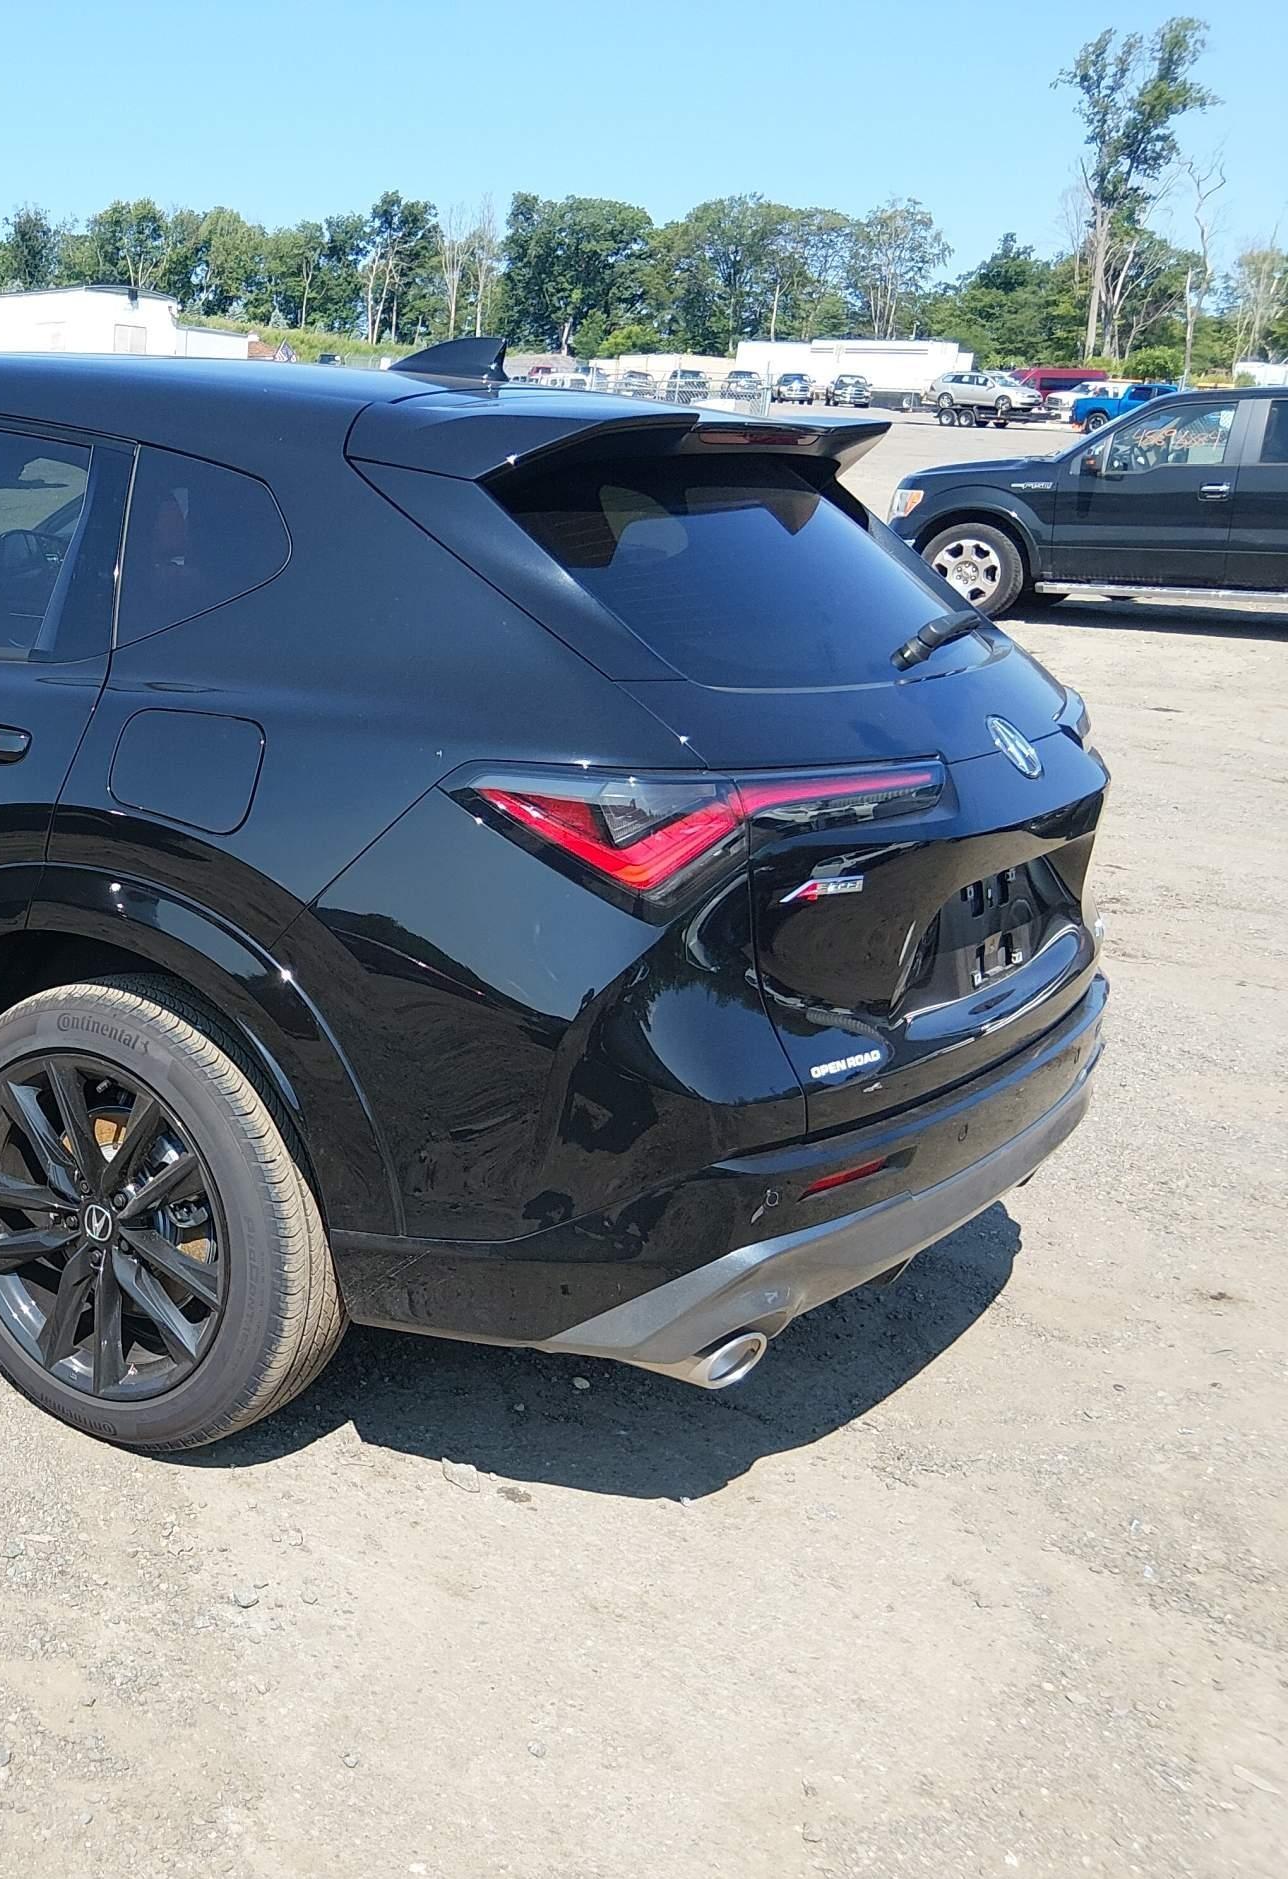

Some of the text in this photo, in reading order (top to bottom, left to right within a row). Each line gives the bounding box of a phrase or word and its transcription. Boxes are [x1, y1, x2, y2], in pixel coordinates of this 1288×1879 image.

[56, 1012, 140, 1050] Continental
[810, 1049, 881, 1079] OPEN ROAD
